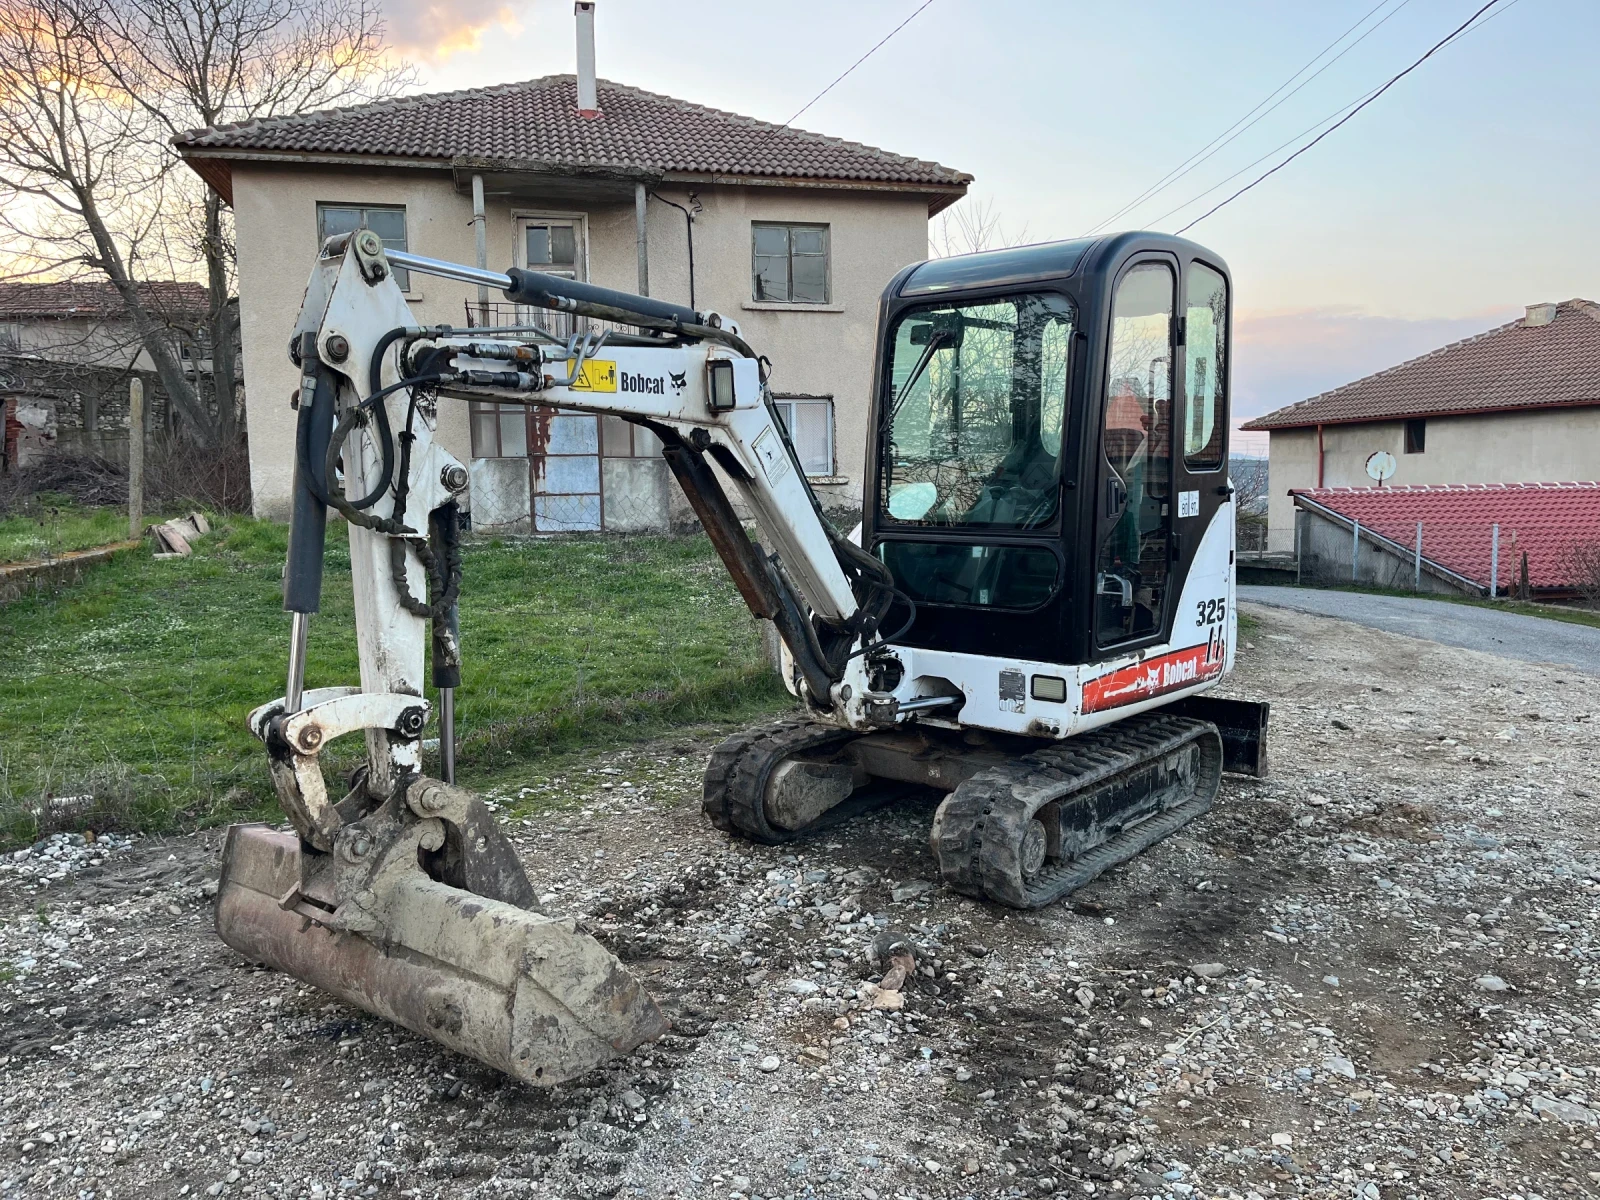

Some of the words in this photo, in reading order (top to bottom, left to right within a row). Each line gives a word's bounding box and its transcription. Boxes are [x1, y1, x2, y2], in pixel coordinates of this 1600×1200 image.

[621, 372, 665, 395] Bobcat
[1195, 597, 1226, 627] 325
[1162, 656, 1198, 688] Bobcat
